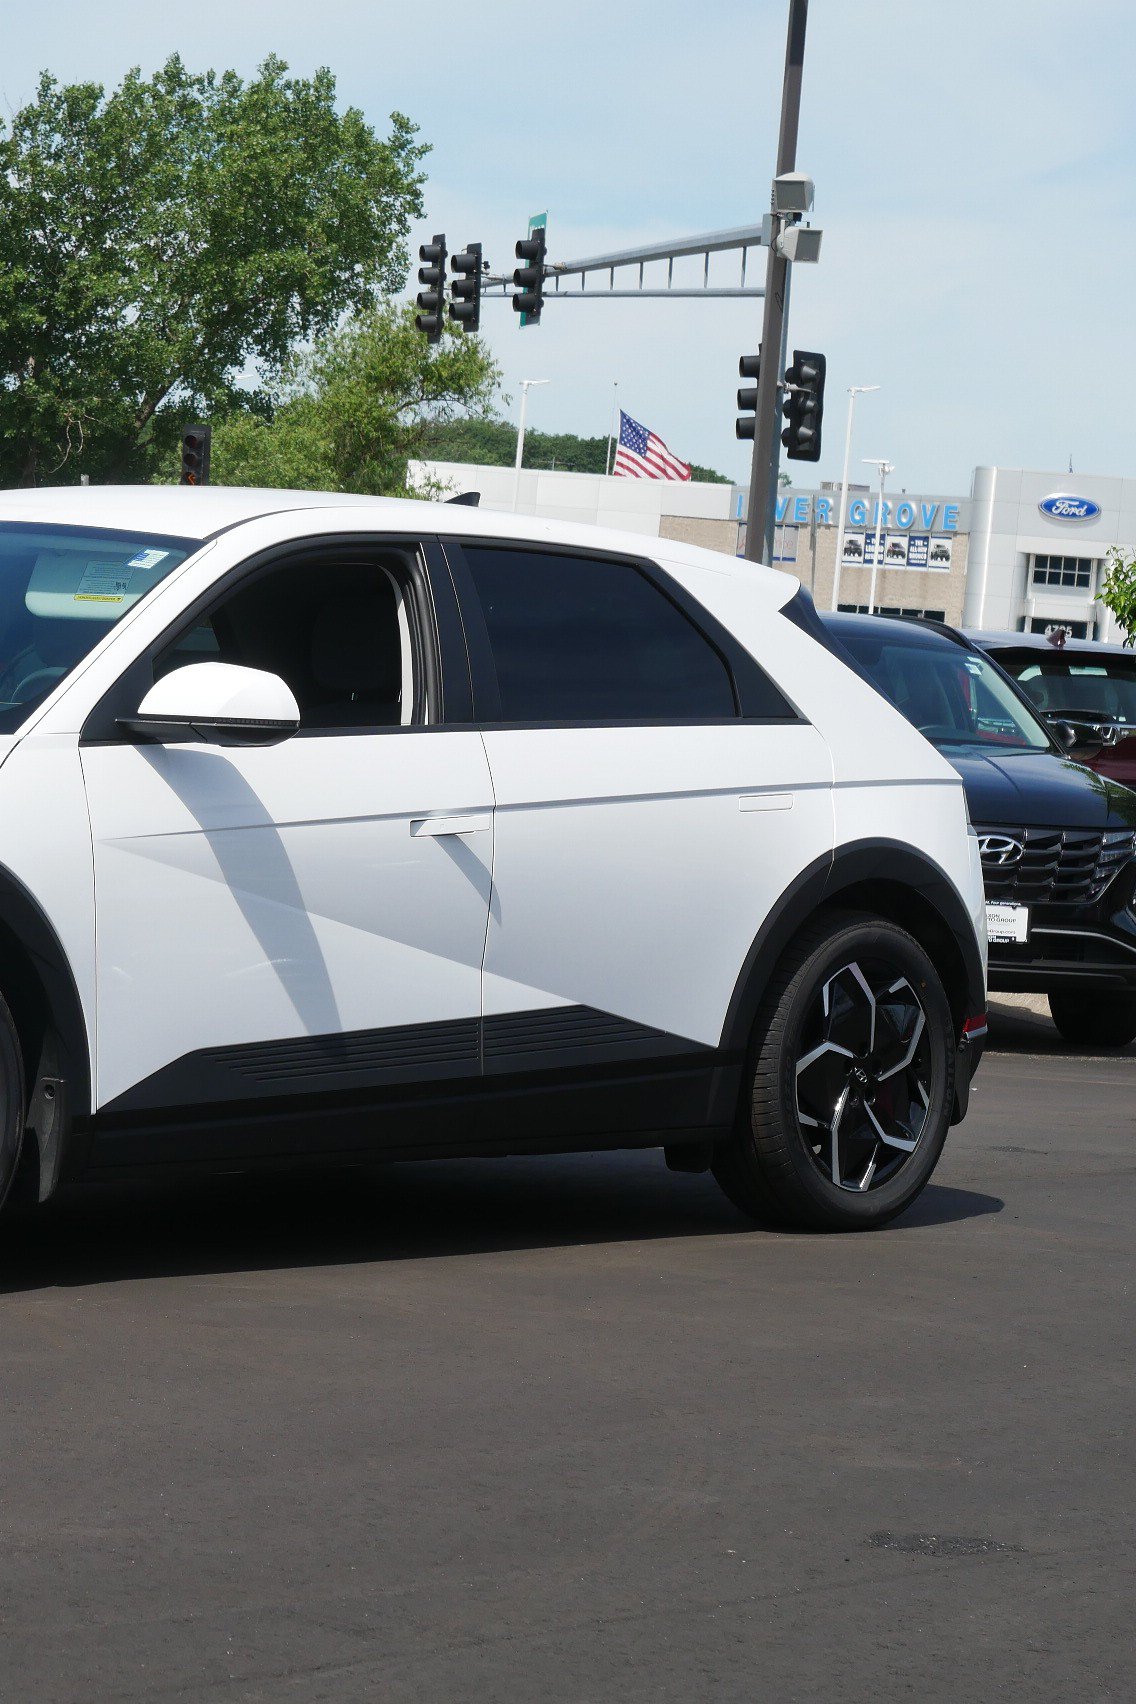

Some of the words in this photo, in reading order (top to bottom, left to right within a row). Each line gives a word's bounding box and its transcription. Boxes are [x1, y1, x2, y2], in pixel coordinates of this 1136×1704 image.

[736, 494, 832, 525] IVER
[848, 499, 960, 531] GROVE
[1051, 500, 1087, 517] Ford
